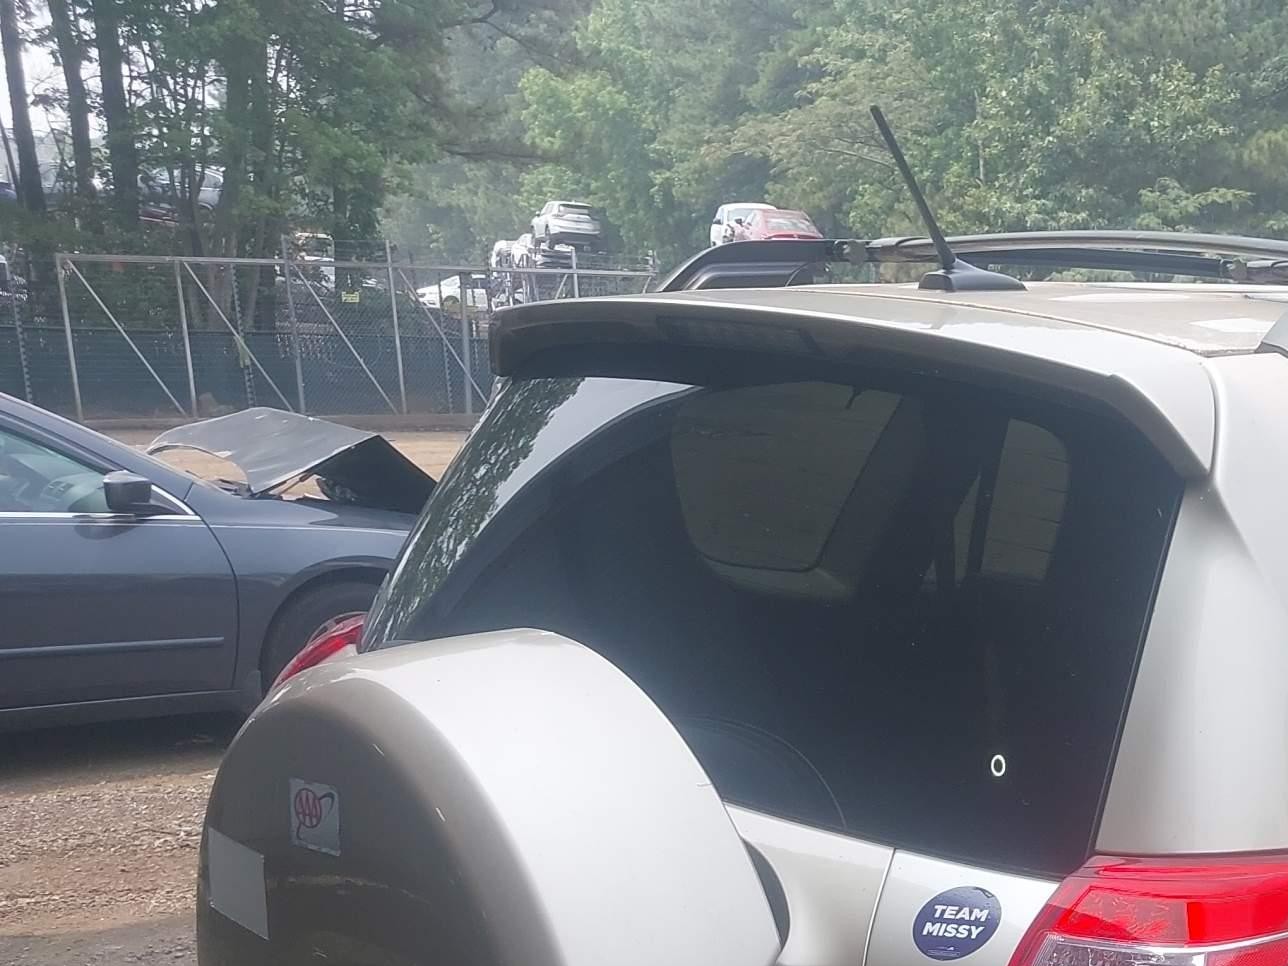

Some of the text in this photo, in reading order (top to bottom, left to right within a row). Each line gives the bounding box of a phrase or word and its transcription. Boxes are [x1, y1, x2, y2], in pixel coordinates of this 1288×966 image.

[296, 791, 321, 823] AAA
[933, 904, 989, 922] TEAM
[922, 921, 985, 940] MISSY
